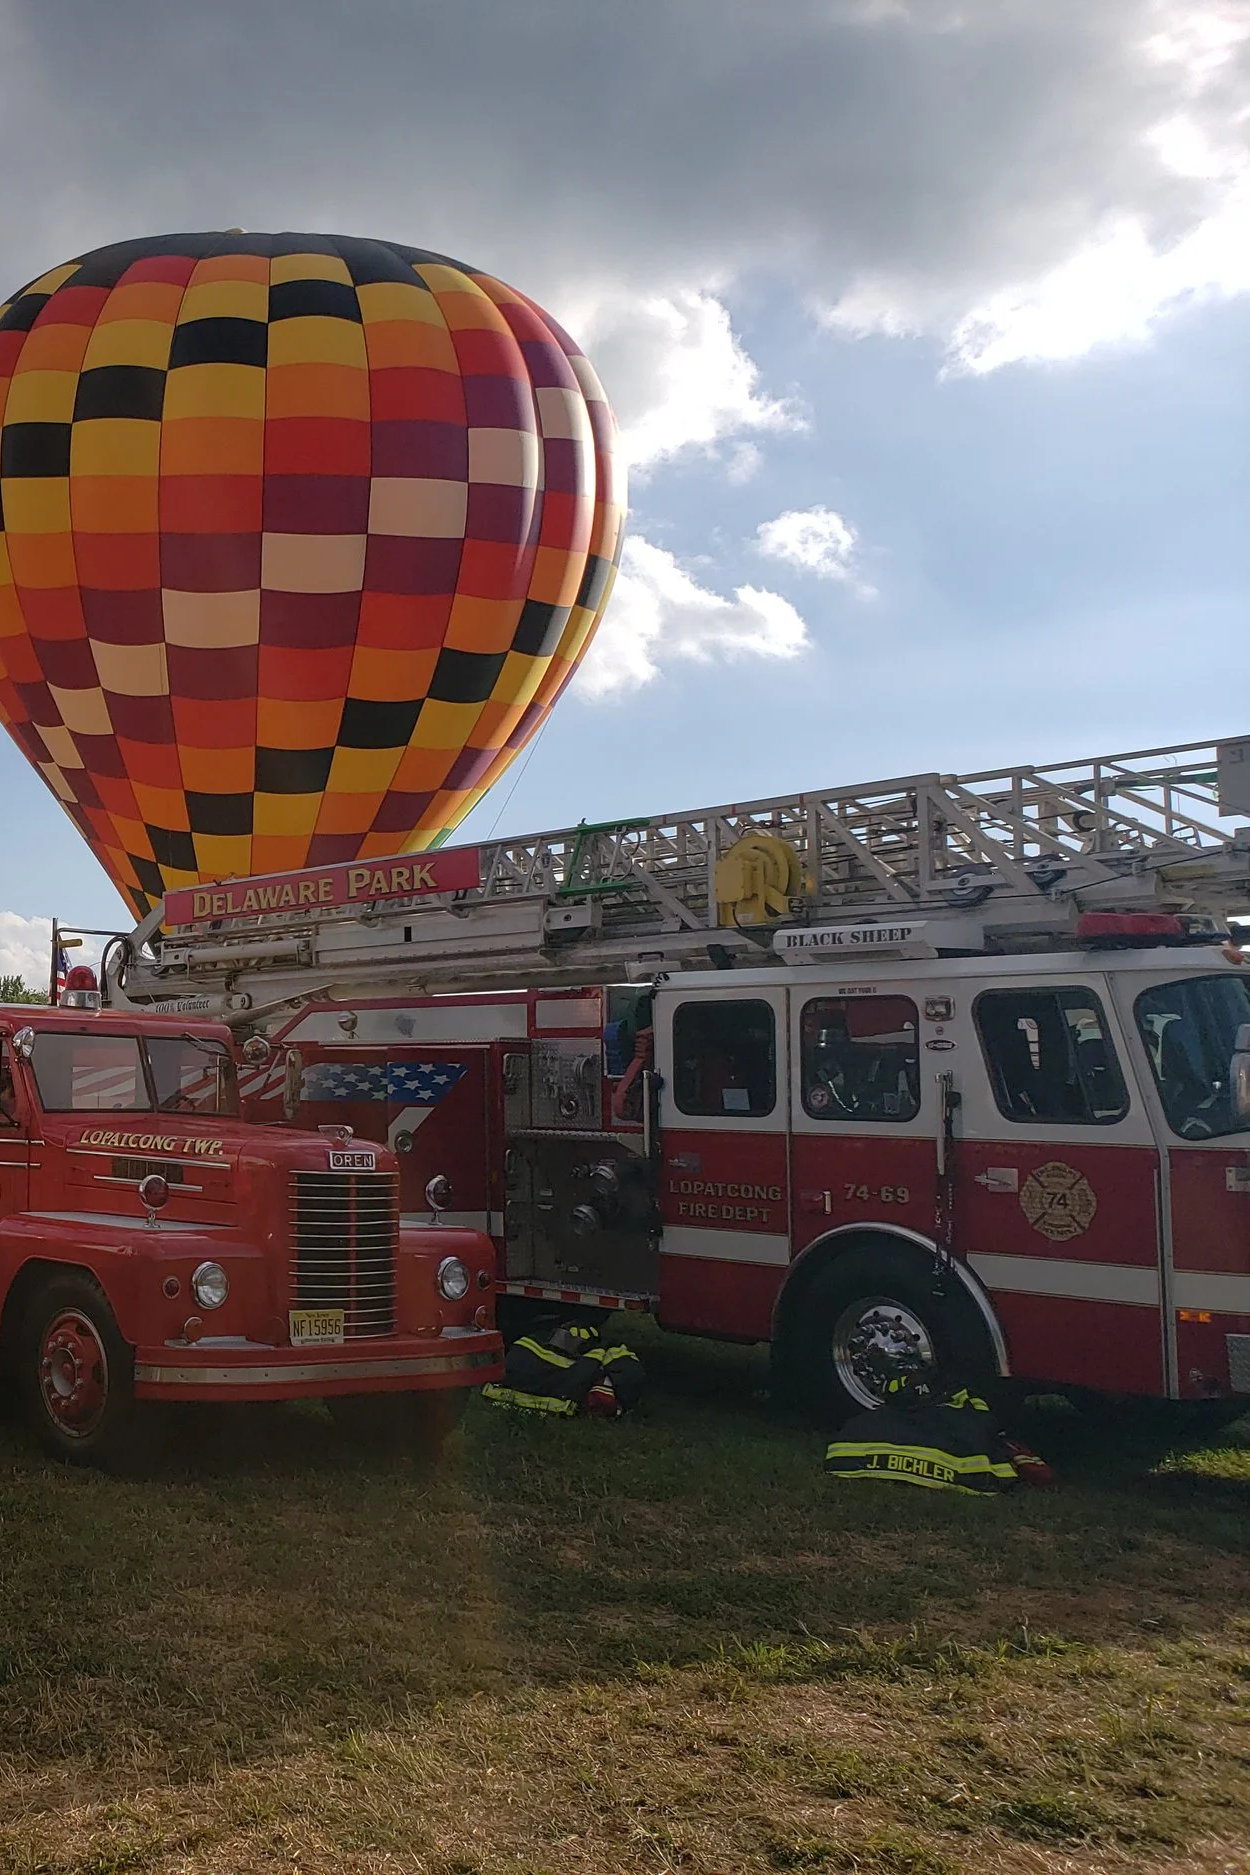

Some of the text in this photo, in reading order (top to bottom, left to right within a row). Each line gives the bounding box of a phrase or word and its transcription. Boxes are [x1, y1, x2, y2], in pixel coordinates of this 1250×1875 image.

[193, 861, 440, 920] DELAWARE PARK
[786, 927, 912, 948] BLACK SHEEP
[80, 1129, 224, 1156] LOPATCONG TWP.
[333, 1154, 372, 1167] OREN
[669, 1180, 781, 1201] LOPATCONG
[843, 1183, 910, 1204] 74-69
[1046, 1191, 1070, 1210] 74
[678, 1201, 771, 1223] FIRE DEPT
[293, 1318, 342, 1337] NF15956
[914, 1383, 931, 1396] 74
[866, 1454, 955, 1482] J. BICHLER
